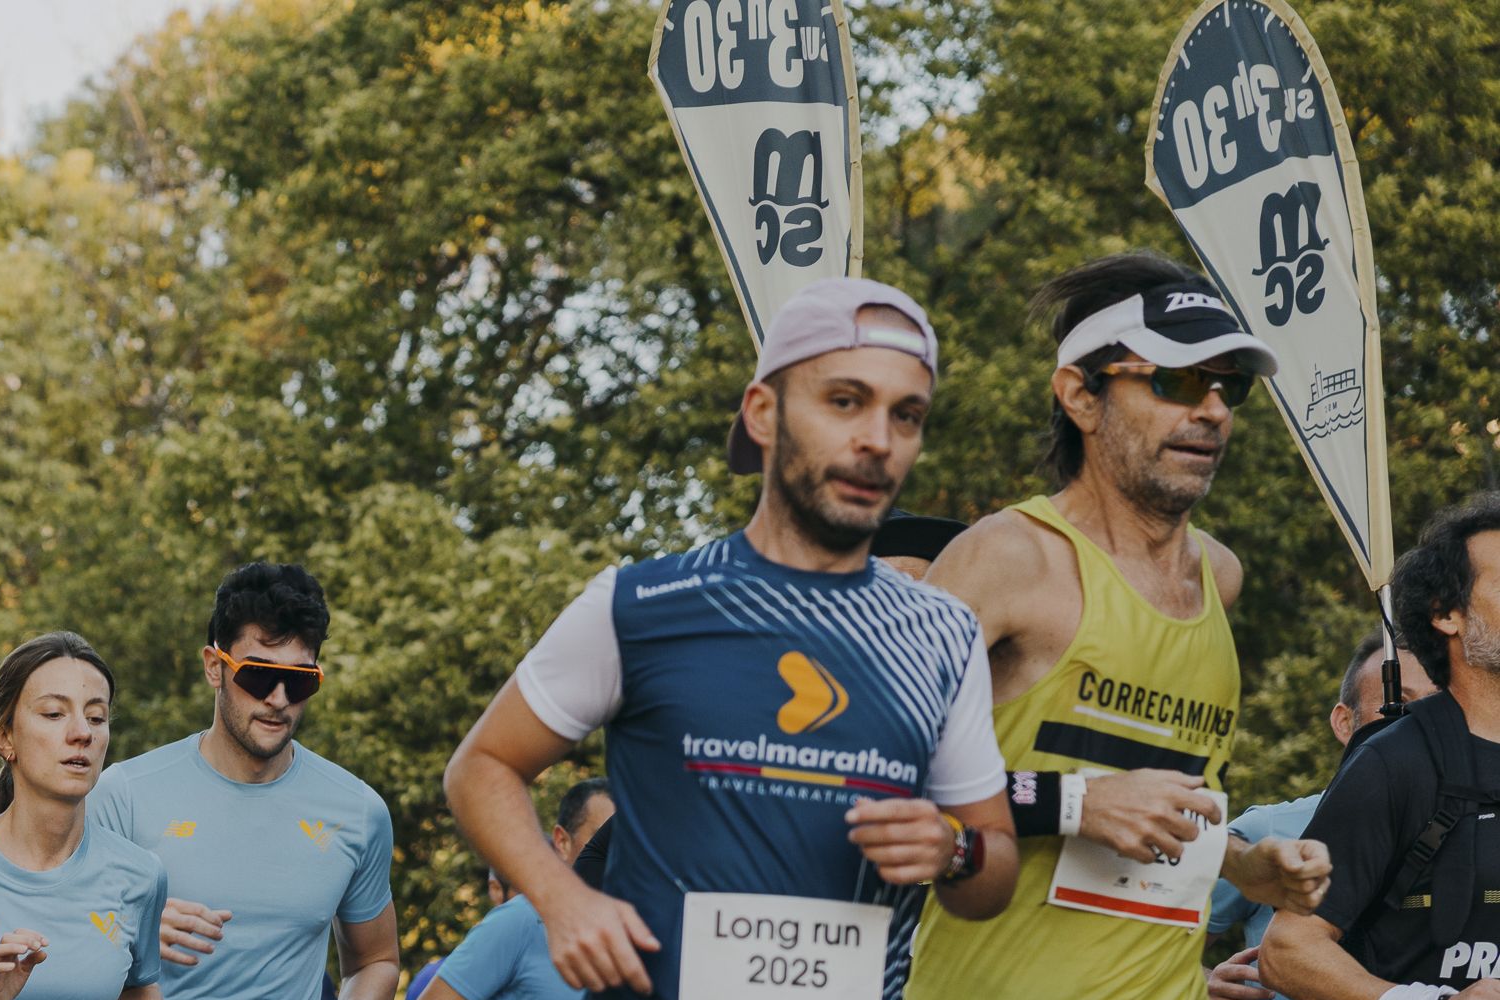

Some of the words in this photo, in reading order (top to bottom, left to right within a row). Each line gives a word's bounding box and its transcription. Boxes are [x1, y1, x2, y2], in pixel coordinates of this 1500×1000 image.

[683, 733, 918, 784] travelmarathon
[715, 909, 800, 950] Long
[813, 922, 861, 947] run
[749, 955, 829, 988] 2025
